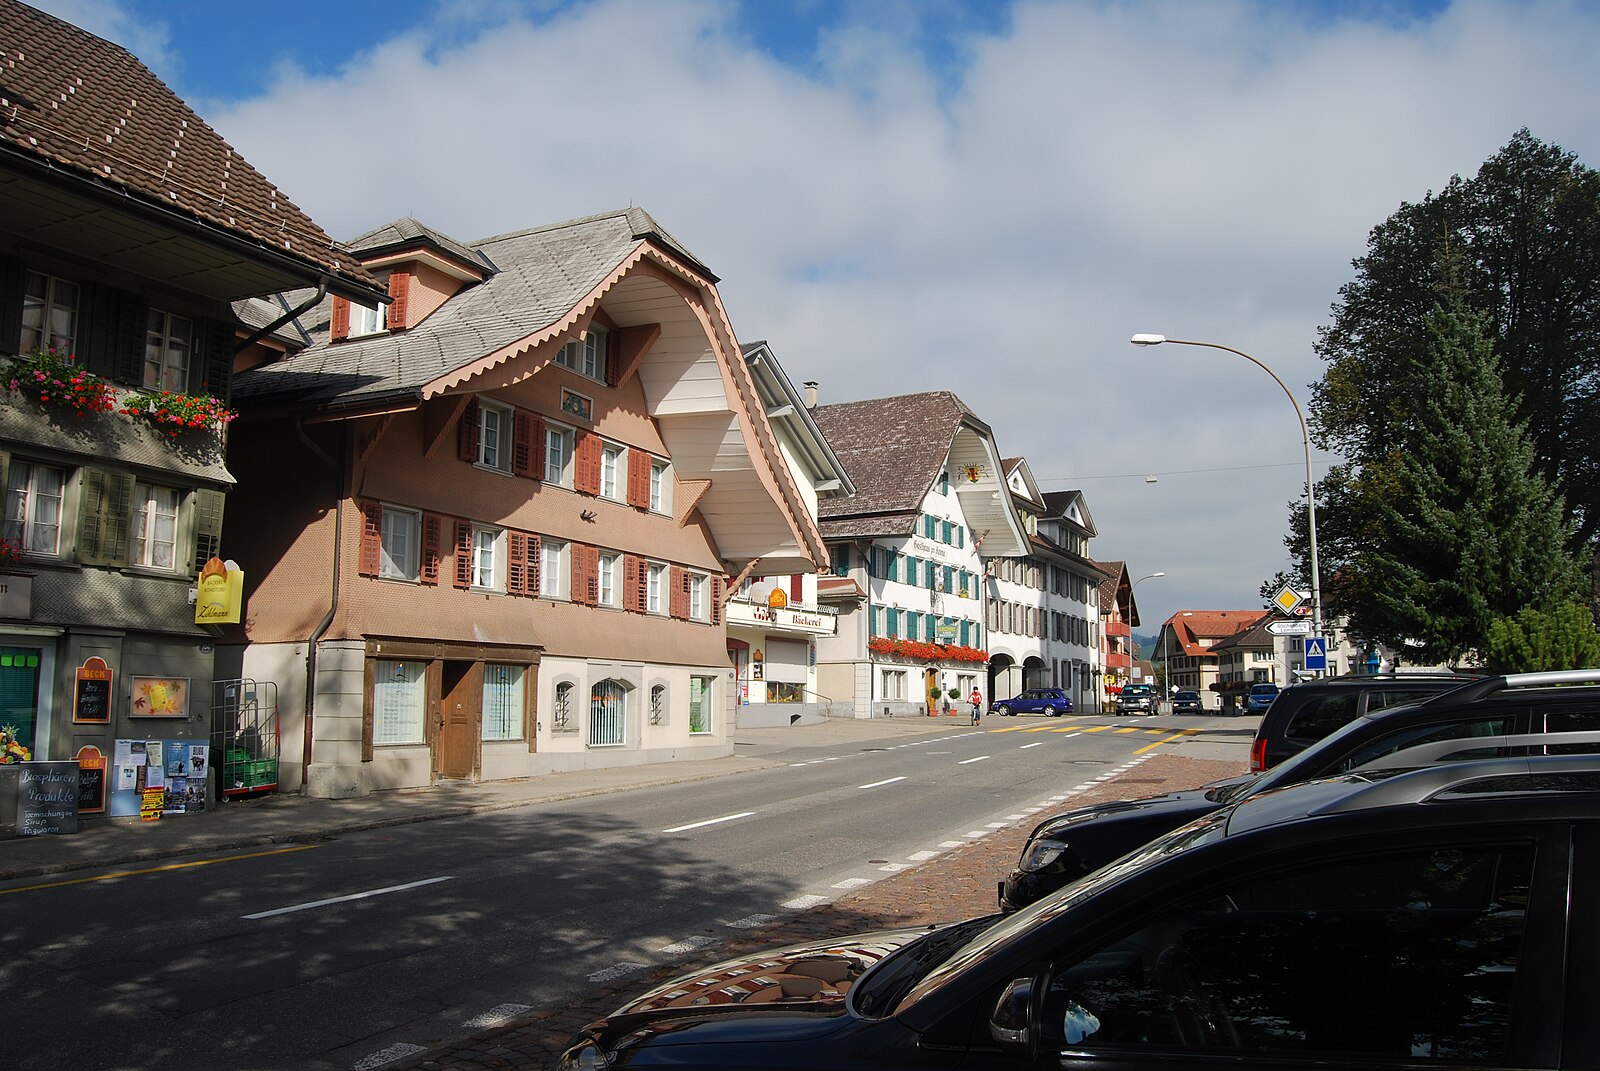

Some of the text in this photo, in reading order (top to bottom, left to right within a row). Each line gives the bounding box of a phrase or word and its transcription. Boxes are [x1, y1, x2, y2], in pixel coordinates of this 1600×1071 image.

[792, 614, 822, 627] Bäckerei
[84, 669, 105, 678] BECK
[22, 768, 75, 784] Biosphären
[29, 786, 74, 802] Produkte
